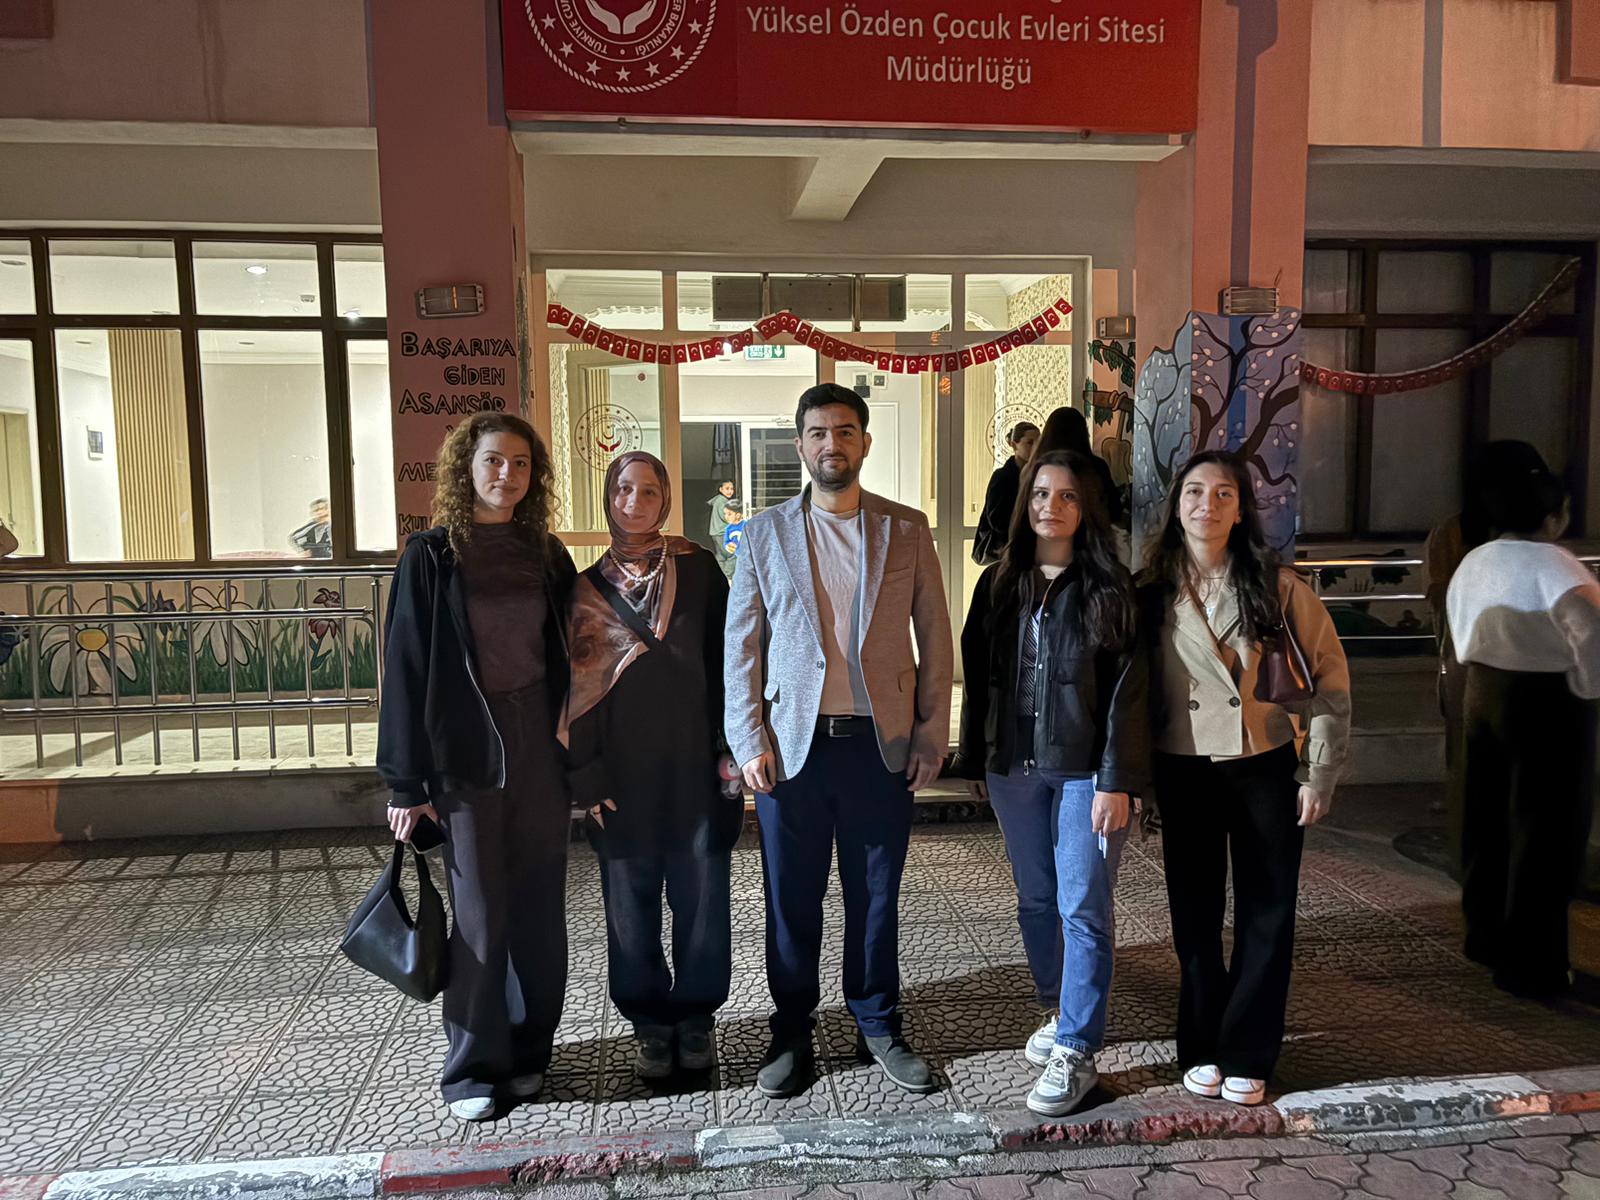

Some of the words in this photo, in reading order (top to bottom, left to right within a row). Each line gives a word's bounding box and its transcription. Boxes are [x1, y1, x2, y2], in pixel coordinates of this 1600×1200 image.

[569, 18, 608, 55] TÜRKİYE
[634, 12, 679, 56] BAKANLIĞI
[746, 6, 831, 34] Yüksel
[840, 3, 924, 38] Özden
[933, 12, 1011, 44] Çocuk
[1020, 14, 1089, 42] Evleri
[1098, 16, 1166, 44] Sitesi
[887, 55, 1032, 91] Müdürlüğü
[401, 331, 516, 359] BAŞARIYA
[444, 364, 505, 386] GİDEN
[399, 389, 506, 415] ASANSÖR
